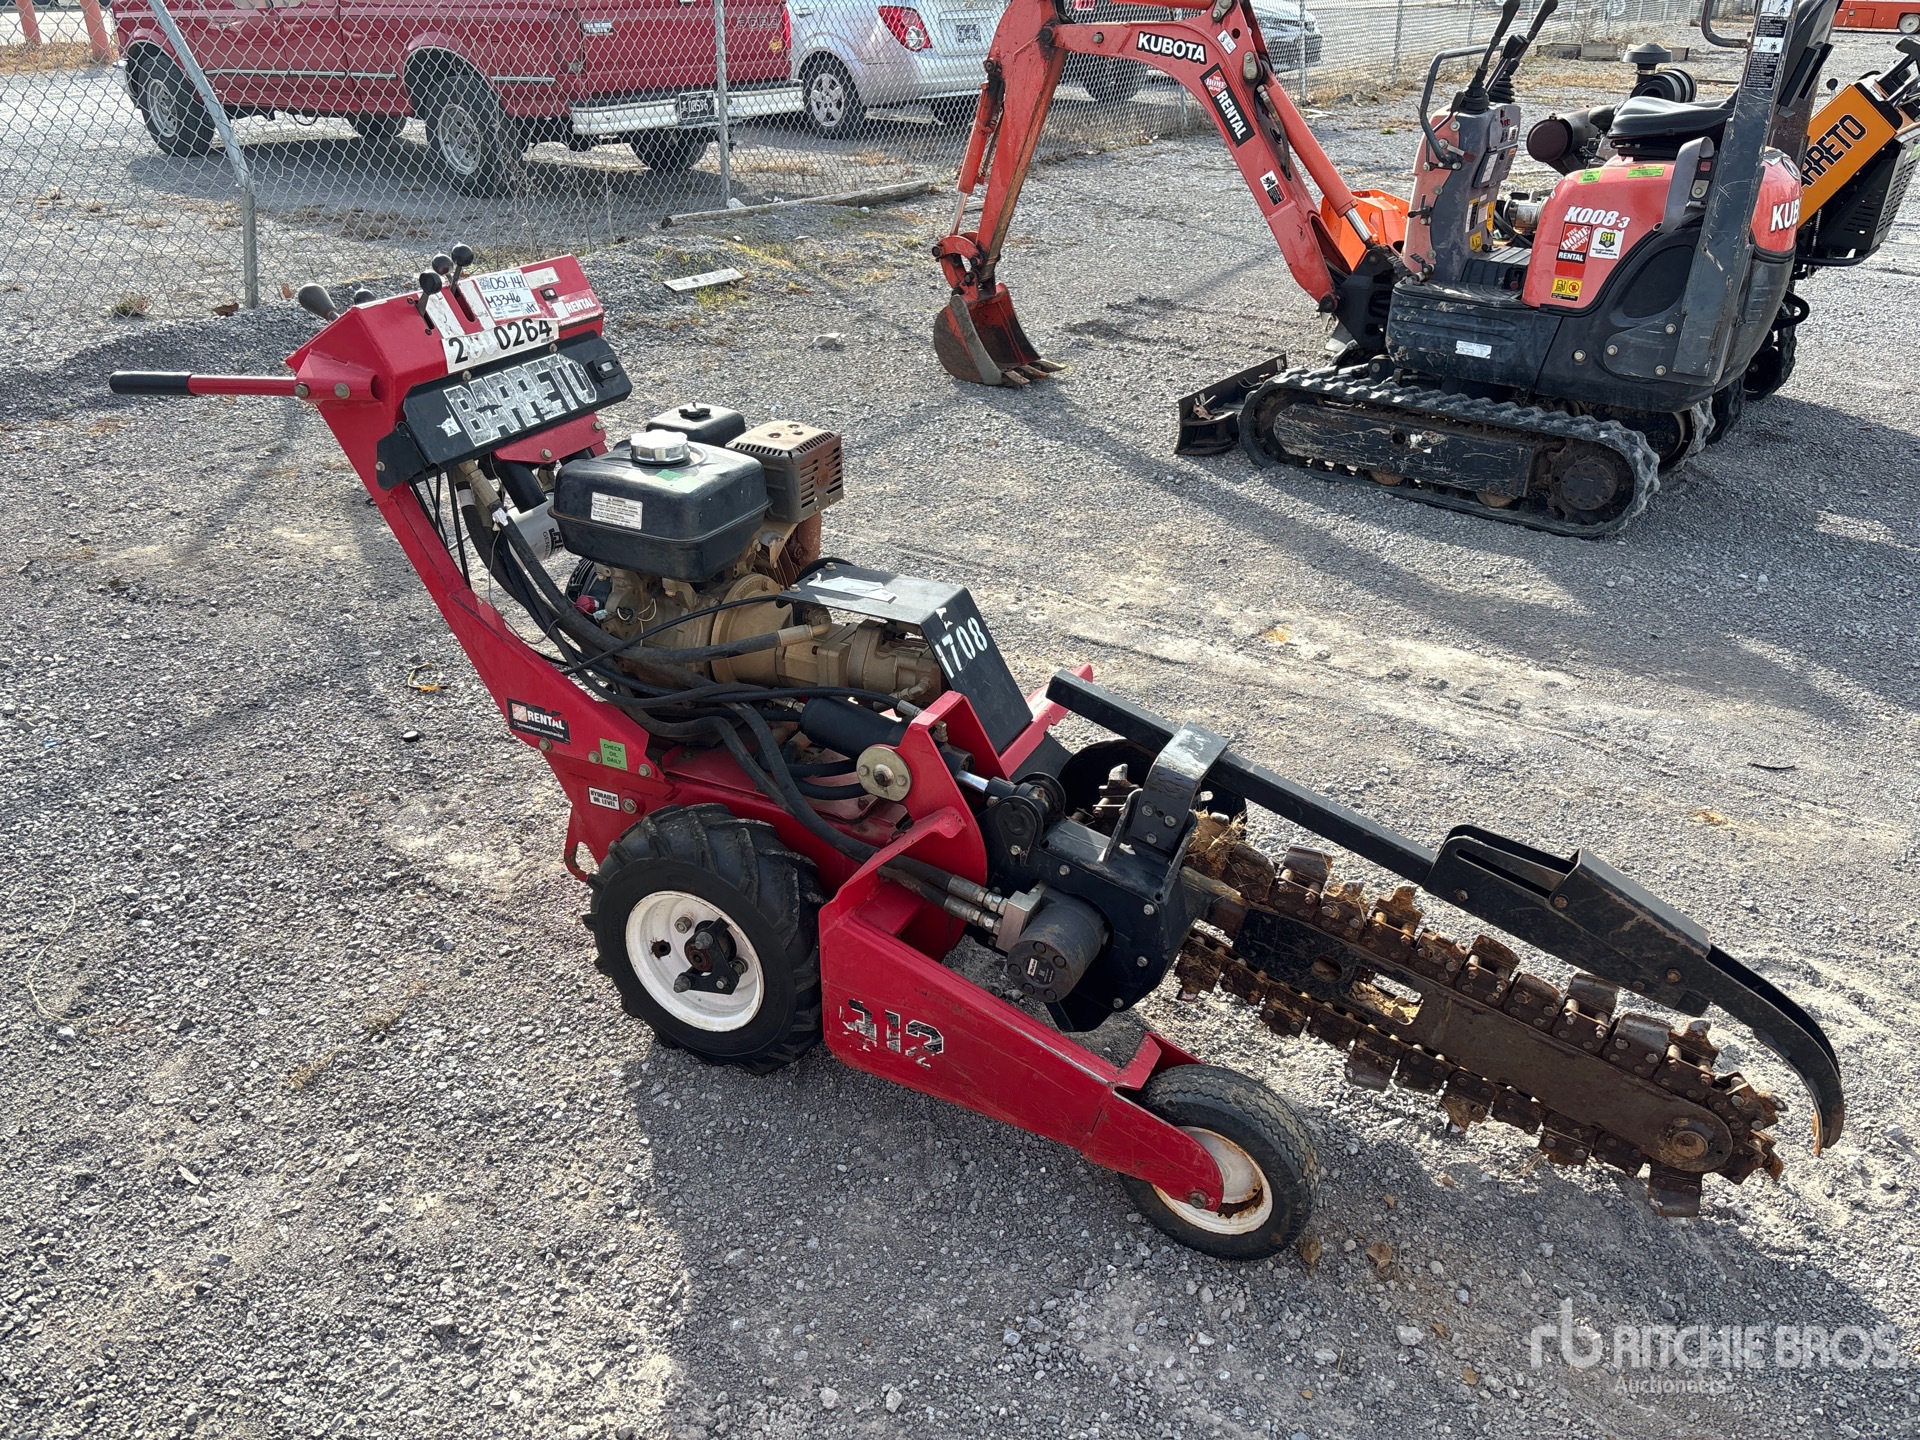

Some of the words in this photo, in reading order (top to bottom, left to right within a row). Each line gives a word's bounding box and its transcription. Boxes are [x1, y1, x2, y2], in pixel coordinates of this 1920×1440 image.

[1137, 32, 1206, 62] KUBOTA
[1206, 78, 1227, 88] HOME
[1217, 90, 1247, 139] RENTAL
[1561, 226, 1590, 250] HOME
[1566, 227, 1578, 238] THE
[1601, 232, 1615, 242] 811
[1571, 236, 1589, 251] DEPOT
[1558, 252, 1584, 261] RENTAL
[565, 297, 596, 313] RENTAL
[443, 353, 597, 447] BARRETO
[935, 617, 988, 678] 1708
[527, 710, 565, 730] RENTAL
[603, 743, 622, 753] CHECK
[608, 750, 618, 758] OIL
[607, 756, 621, 765] DAILY
